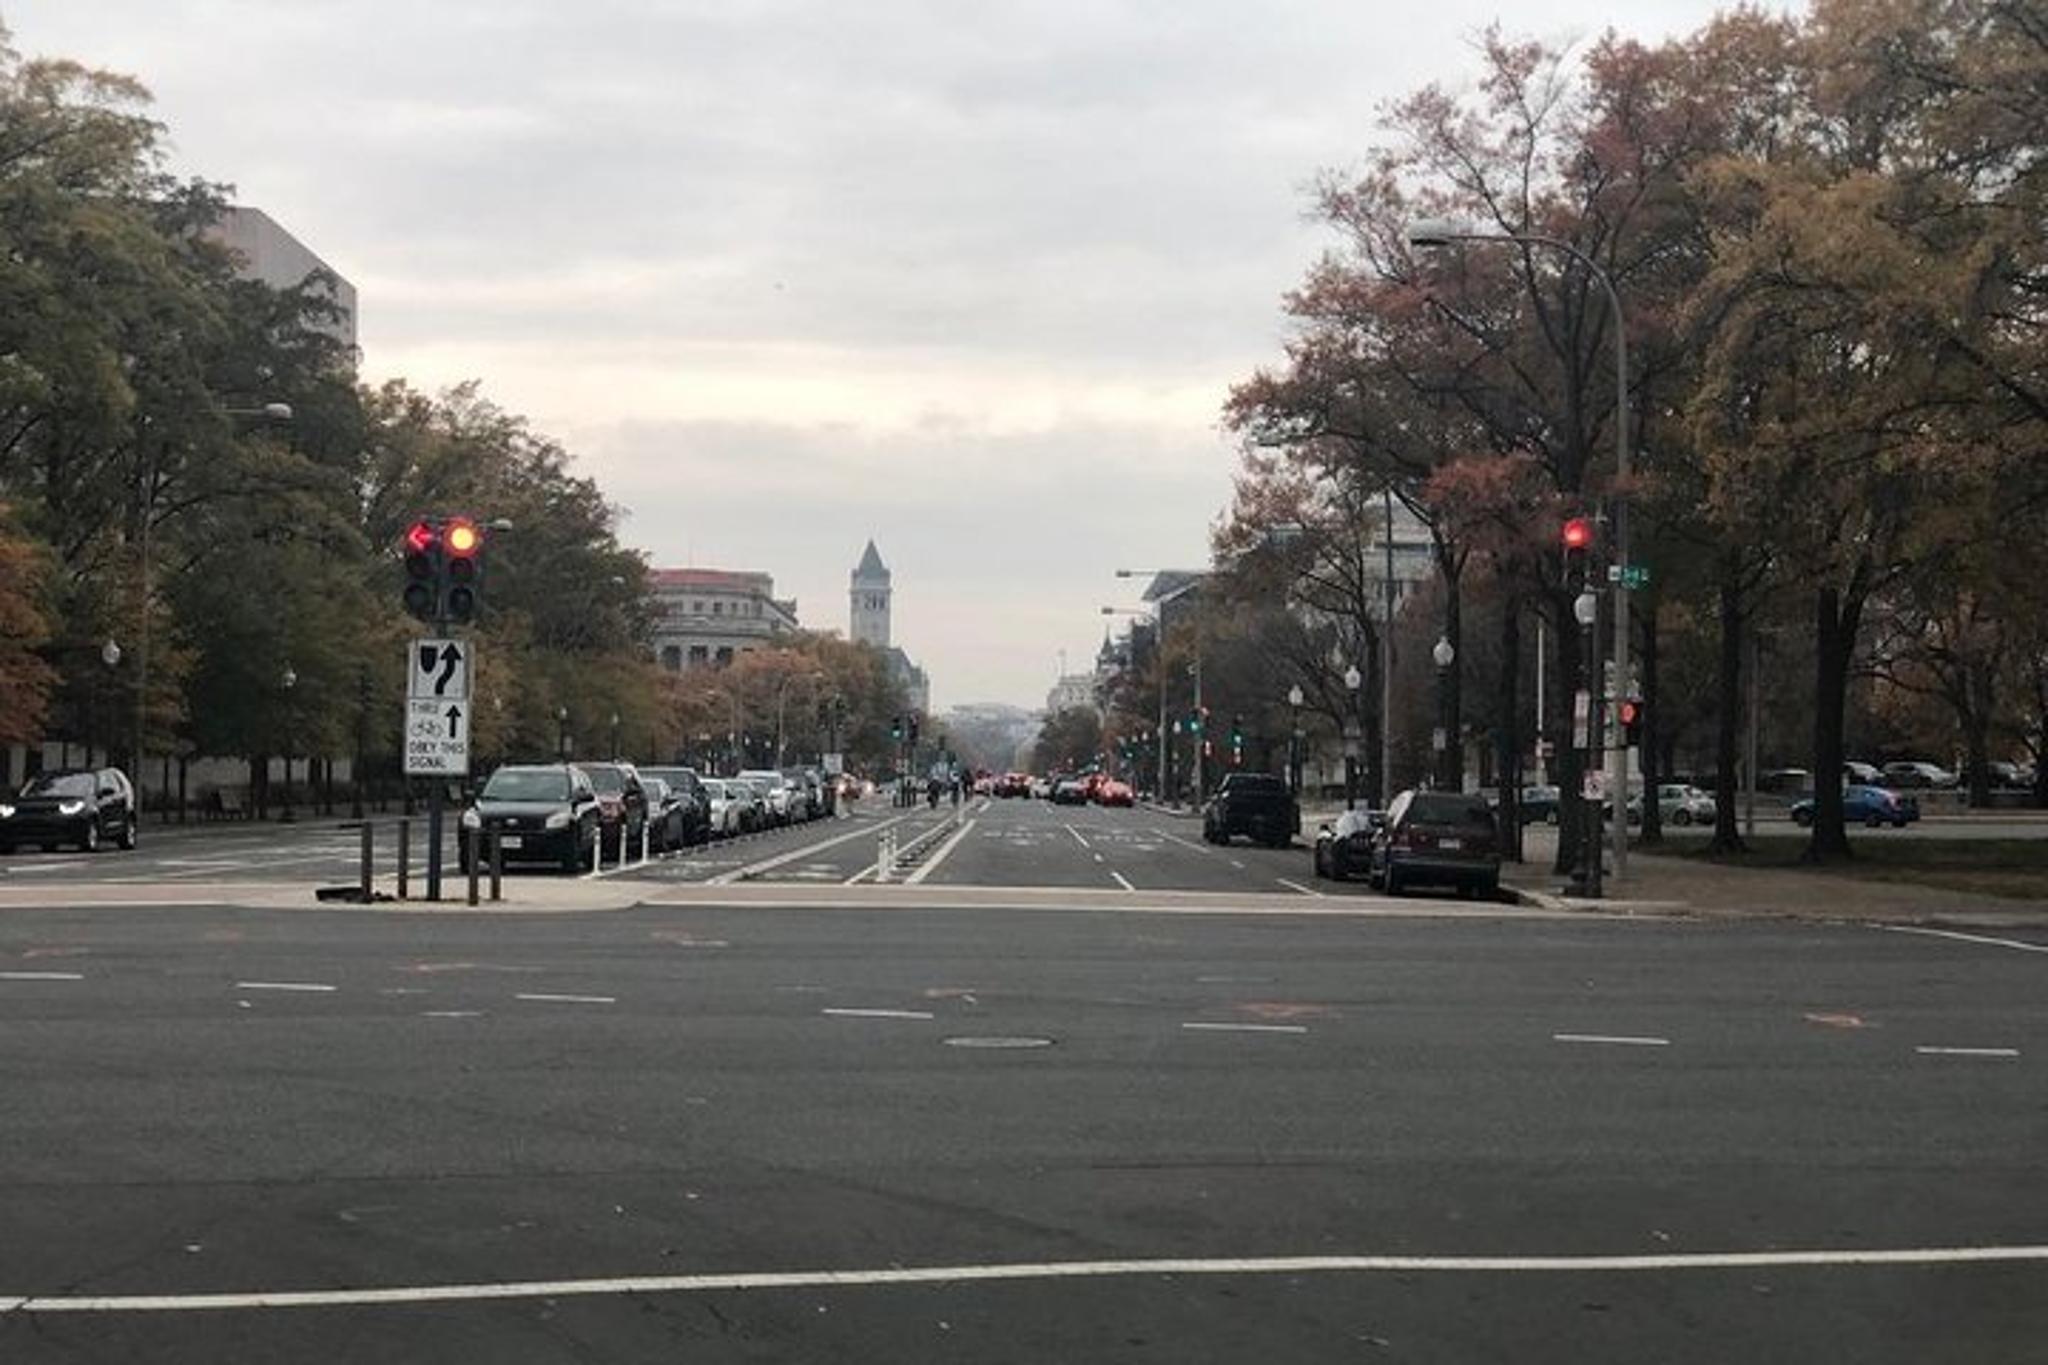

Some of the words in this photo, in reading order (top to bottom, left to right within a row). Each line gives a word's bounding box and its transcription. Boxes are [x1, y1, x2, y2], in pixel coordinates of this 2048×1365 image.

[409, 742, 436, 754] OBEY
[441, 742, 464, 754] THIS
[409, 757, 446, 769] SIGNAL
